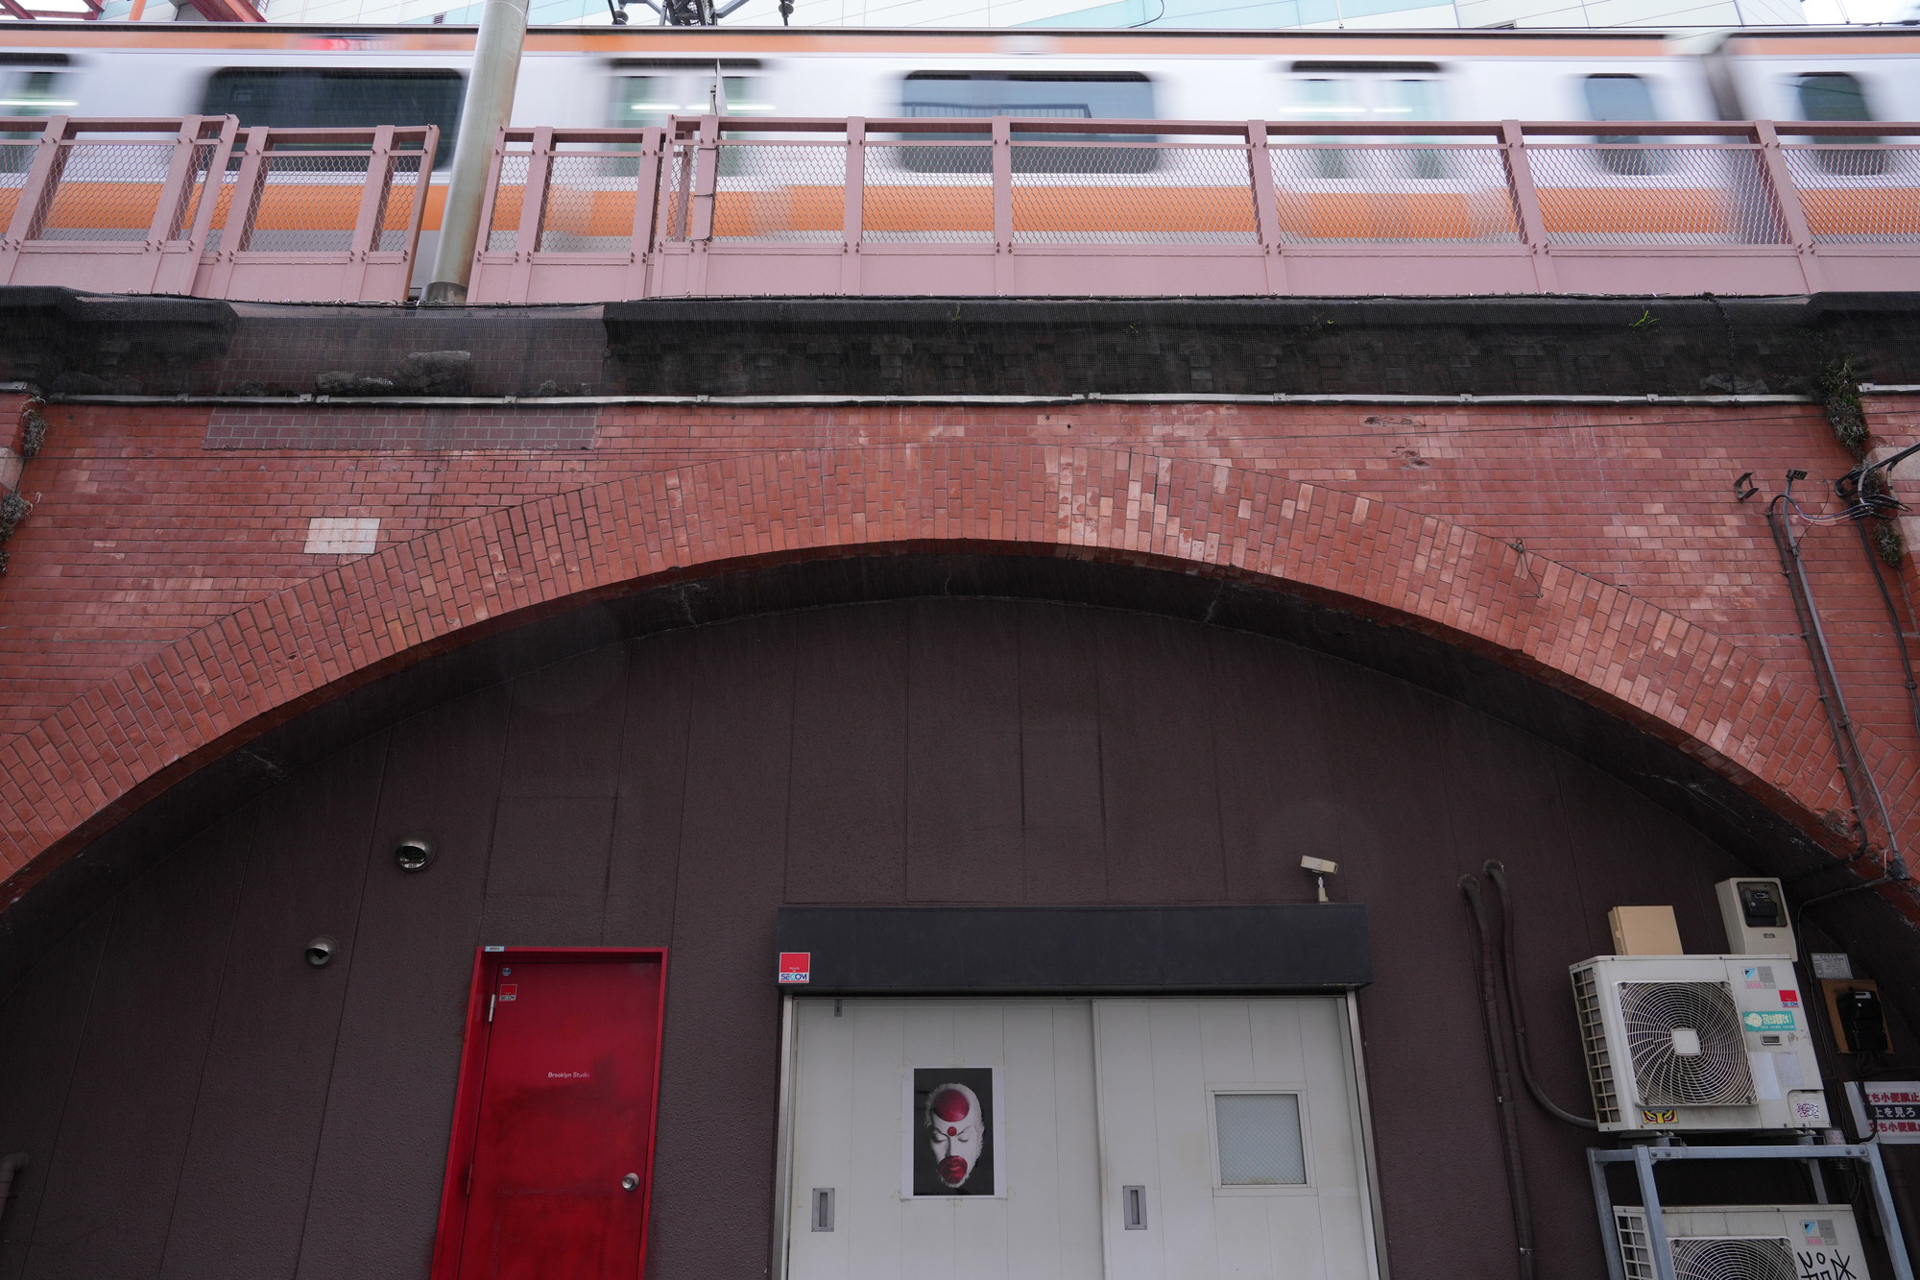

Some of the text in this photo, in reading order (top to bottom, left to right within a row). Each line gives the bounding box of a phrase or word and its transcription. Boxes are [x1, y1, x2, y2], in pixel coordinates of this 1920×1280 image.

[781, 973, 807, 981] SECOM
[548, 1071, 572, 1079] Brooklyn
[1875, 1106, 1916, 1118] 上を見ろ
[1868, 1121, 1920, 1132] 立ち小便禁
